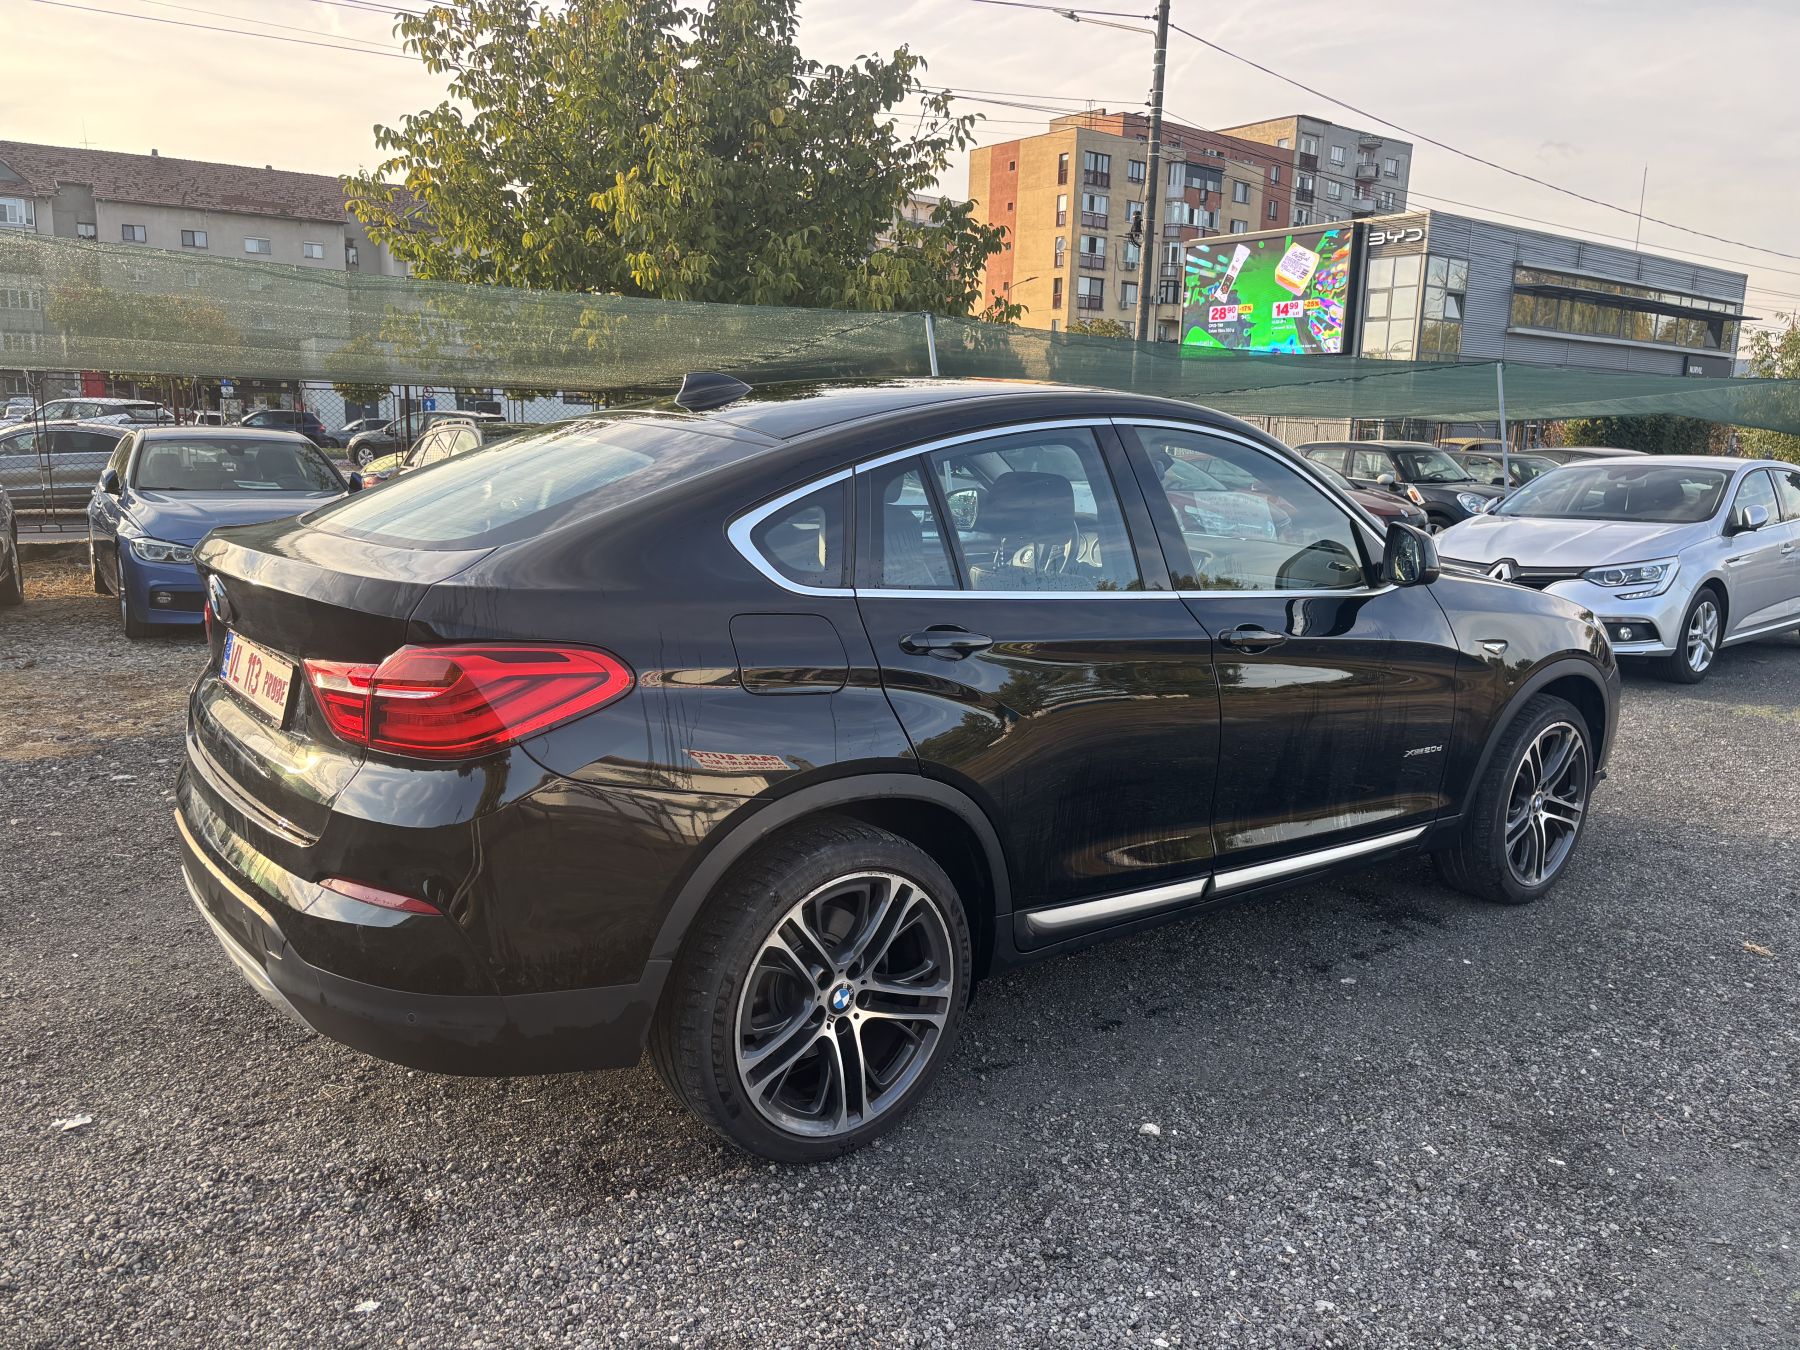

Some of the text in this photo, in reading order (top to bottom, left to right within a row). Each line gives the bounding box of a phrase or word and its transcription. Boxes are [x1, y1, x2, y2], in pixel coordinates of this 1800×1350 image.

[1368, 228, 1423, 246] BYD
[1211, 307, 1227, 321] 28
[1275, 303, 1289, 317] 14
[244, 652, 262, 694] 113
